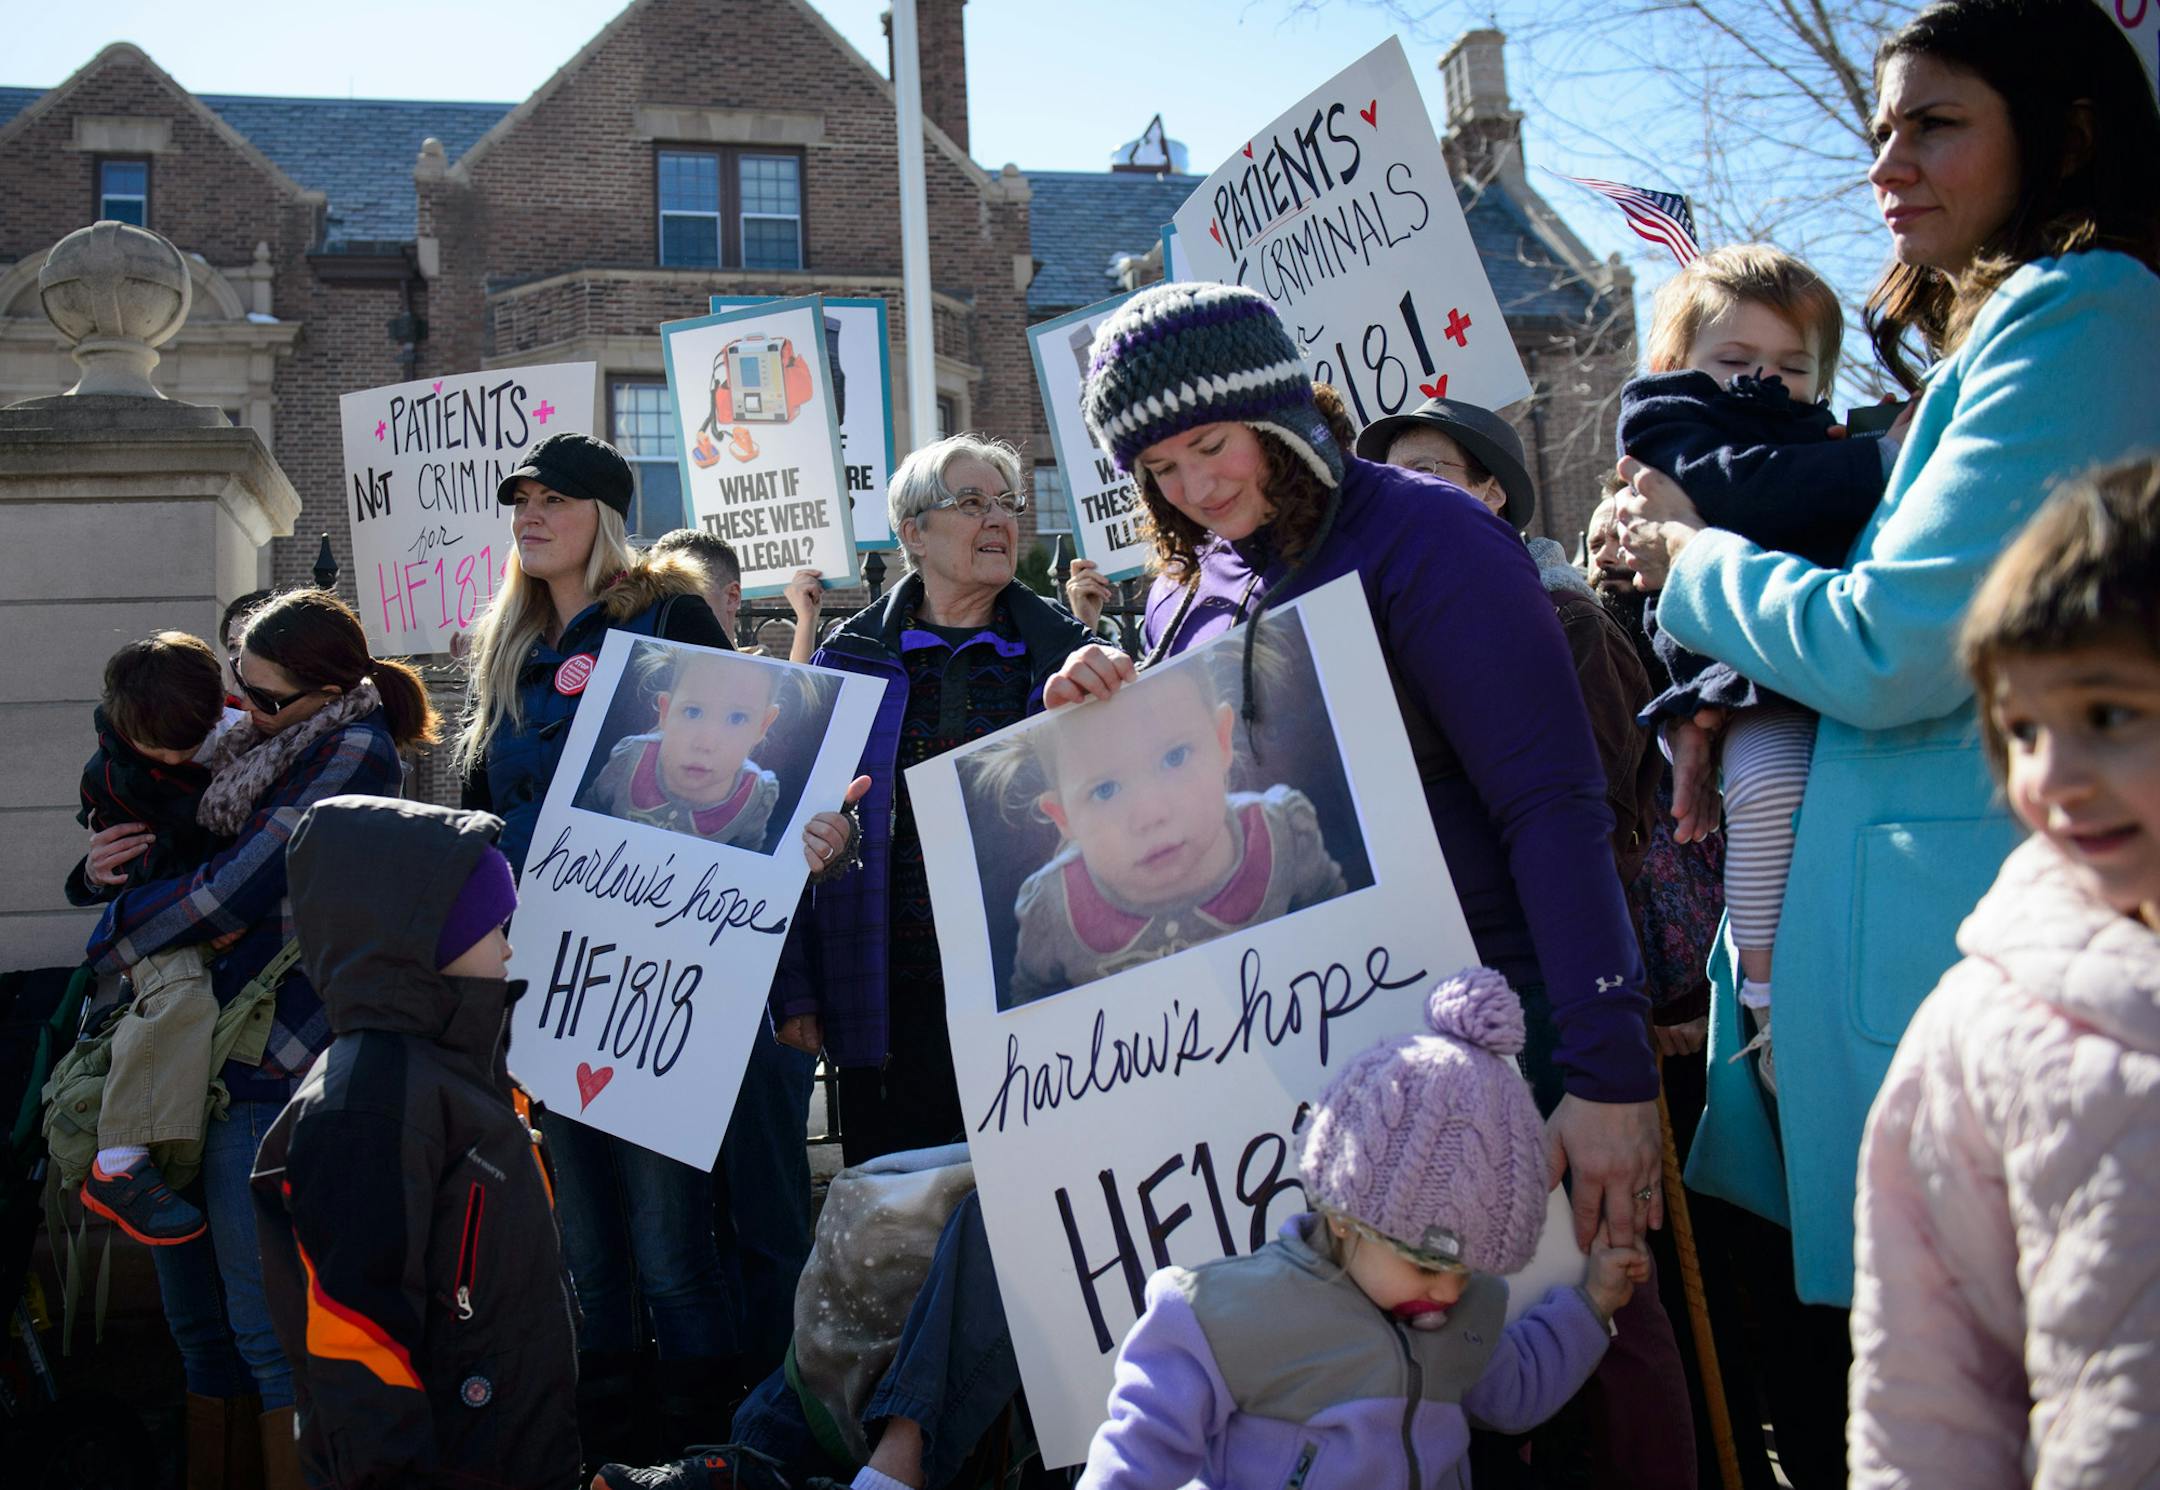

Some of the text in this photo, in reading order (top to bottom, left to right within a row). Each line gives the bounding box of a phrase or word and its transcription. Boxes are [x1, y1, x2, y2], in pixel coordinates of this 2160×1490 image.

[1214, 103, 1360, 263] PATIENTS
[1260, 163, 1429, 305] CRIMINALS
[390, 380, 528, 455] PATIENTS
[408, 525, 463, 564] for
[702, 507, 768, 540] THESE
[768, 499, 830, 534] WERE
[719, 467, 800, 505] WHAT IF
[378, 545, 507, 633] HF181
[529, 826, 787, 946] harlow's hope
[538, 930, 703, 1077] HF1818
[978, 946, 1428, 1133] harlow's hope
[1055, 1101, 1311, 1354] HF18
